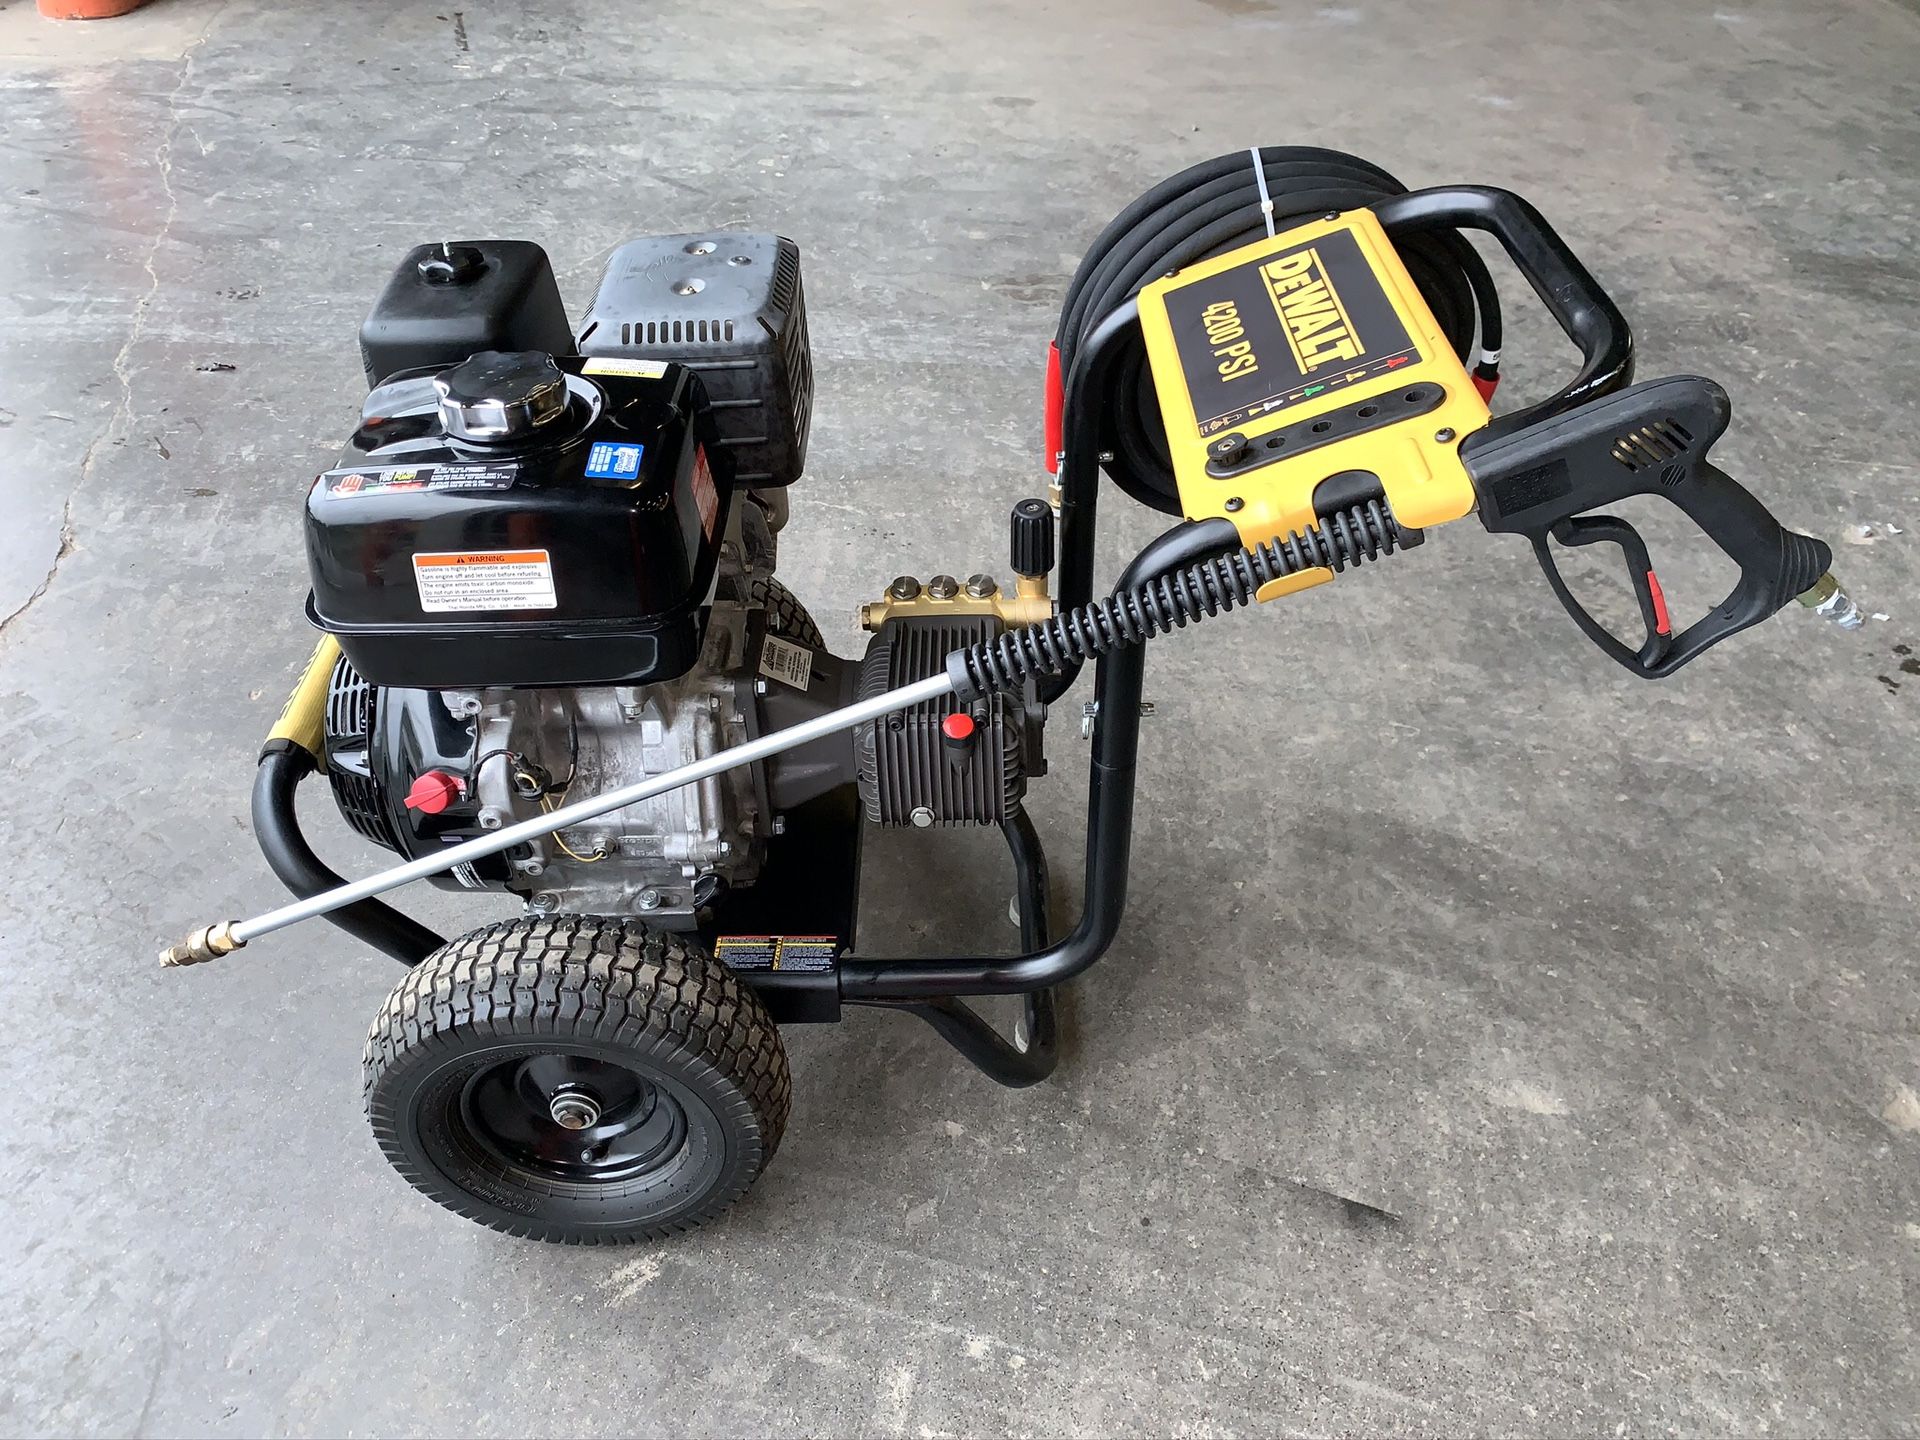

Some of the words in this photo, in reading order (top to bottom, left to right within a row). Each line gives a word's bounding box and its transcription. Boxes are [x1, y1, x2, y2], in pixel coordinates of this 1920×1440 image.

[1201, 300, 1245, 346] 4200
[1213, 339, 1259, 384] PSI
[467, 555, 505, 563] WARNING
